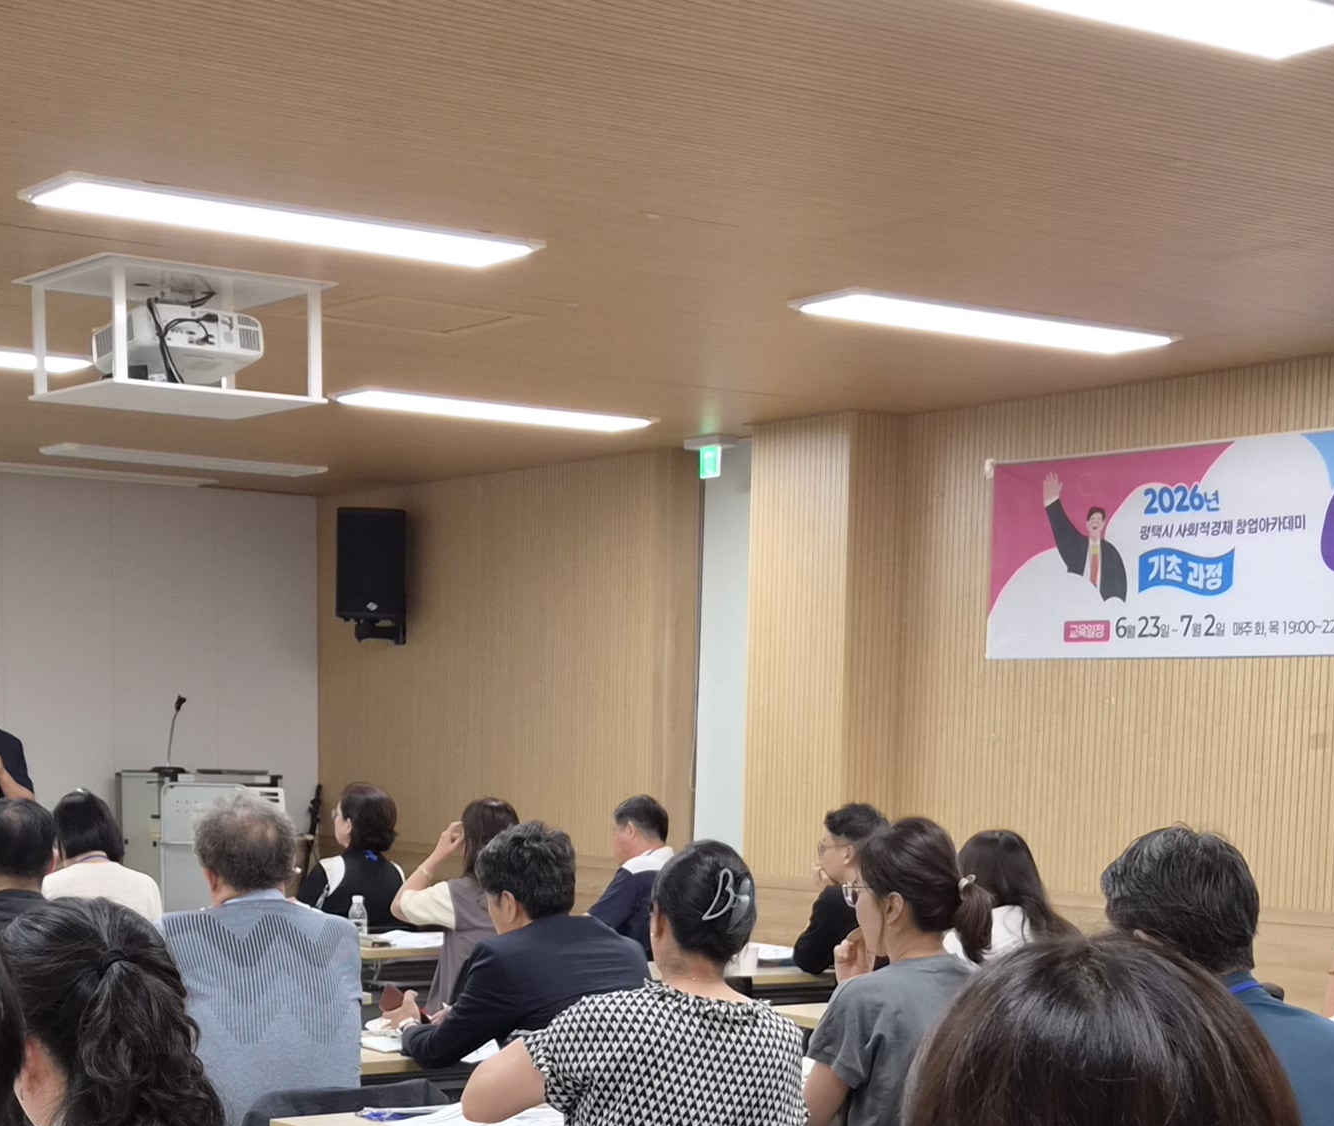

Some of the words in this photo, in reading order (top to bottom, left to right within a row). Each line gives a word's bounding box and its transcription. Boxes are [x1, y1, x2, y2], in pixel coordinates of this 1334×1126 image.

[1143, 484, 1220, 515] 2026년
[1139, 524, 1174, 540] 평택시
[1175, 520, 1234, 538] 사회적경제
[1236, 514, 1306, 535] 창업아카데미
[1148, 554, 1183, 582] 기초
[1187, 561, 1223, 590] 과정
[1069, 624, 1105, 639] 교육일정
[1233, 622, 1253, 636] 매주
[1269, 620, 1279, 635] 목
